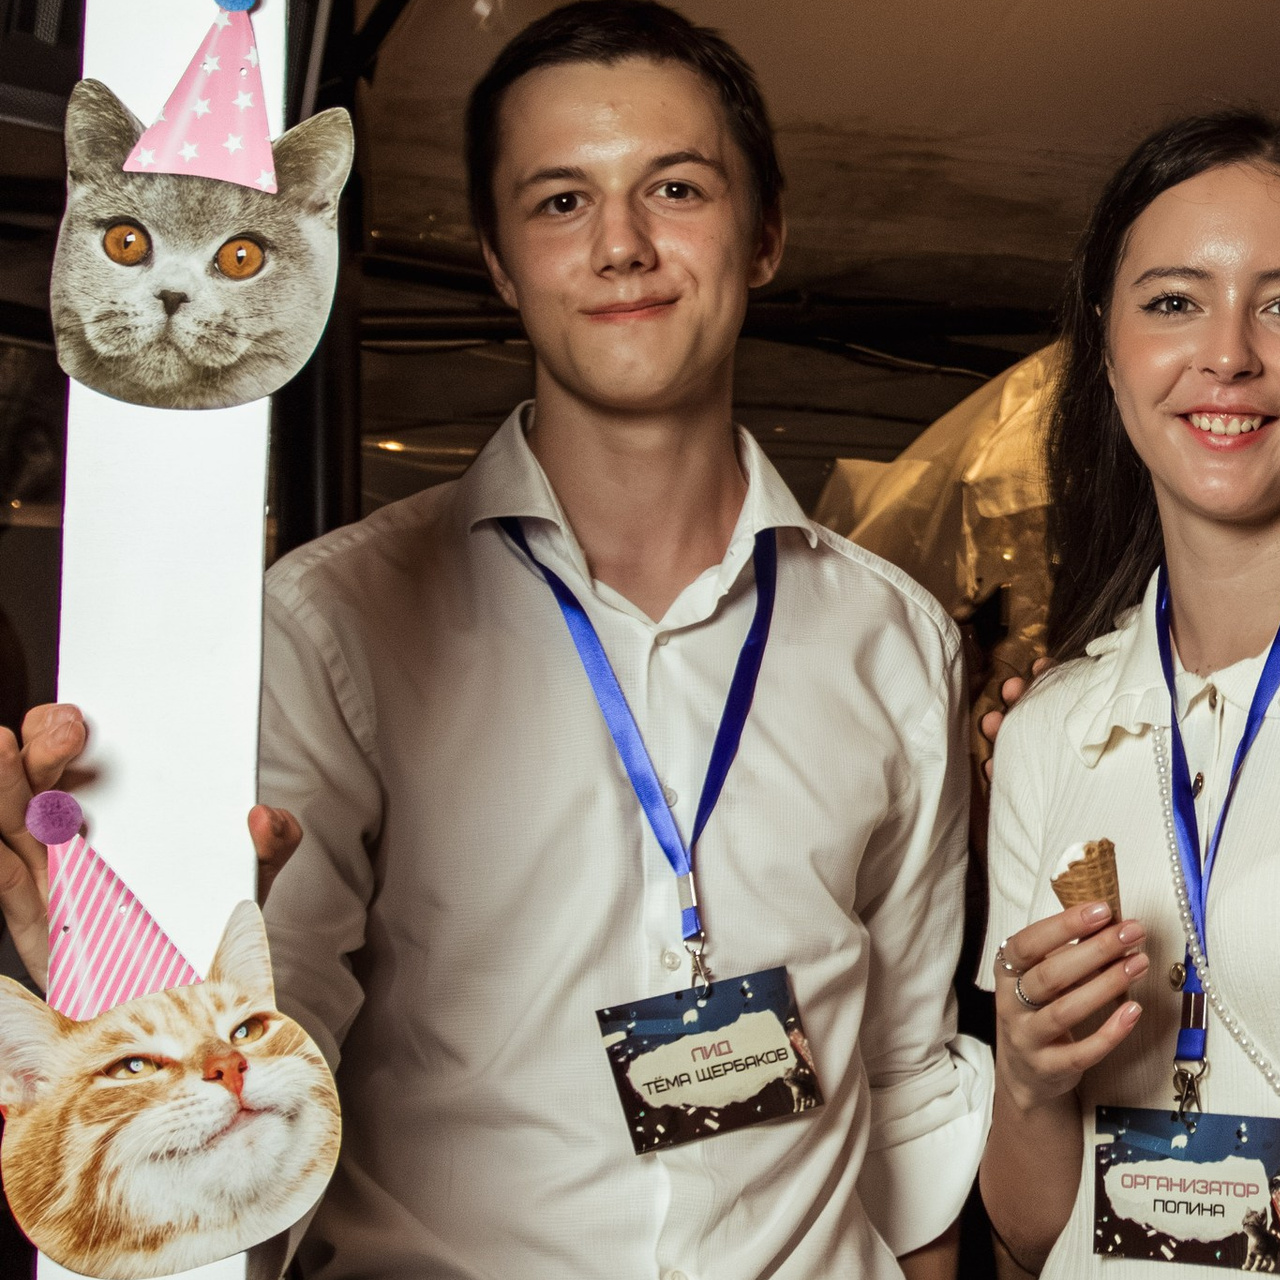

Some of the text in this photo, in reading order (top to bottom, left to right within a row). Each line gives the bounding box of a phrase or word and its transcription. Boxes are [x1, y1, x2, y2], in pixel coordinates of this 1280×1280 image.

[642, 1047, 789, 1096] ТЁМА ЩЕРБАКОВ
[1120, 1173, 1260, 1198] ОРГАНИЗАТОР
[1153, 1198, 1225, 1217] ПОЛИНА
